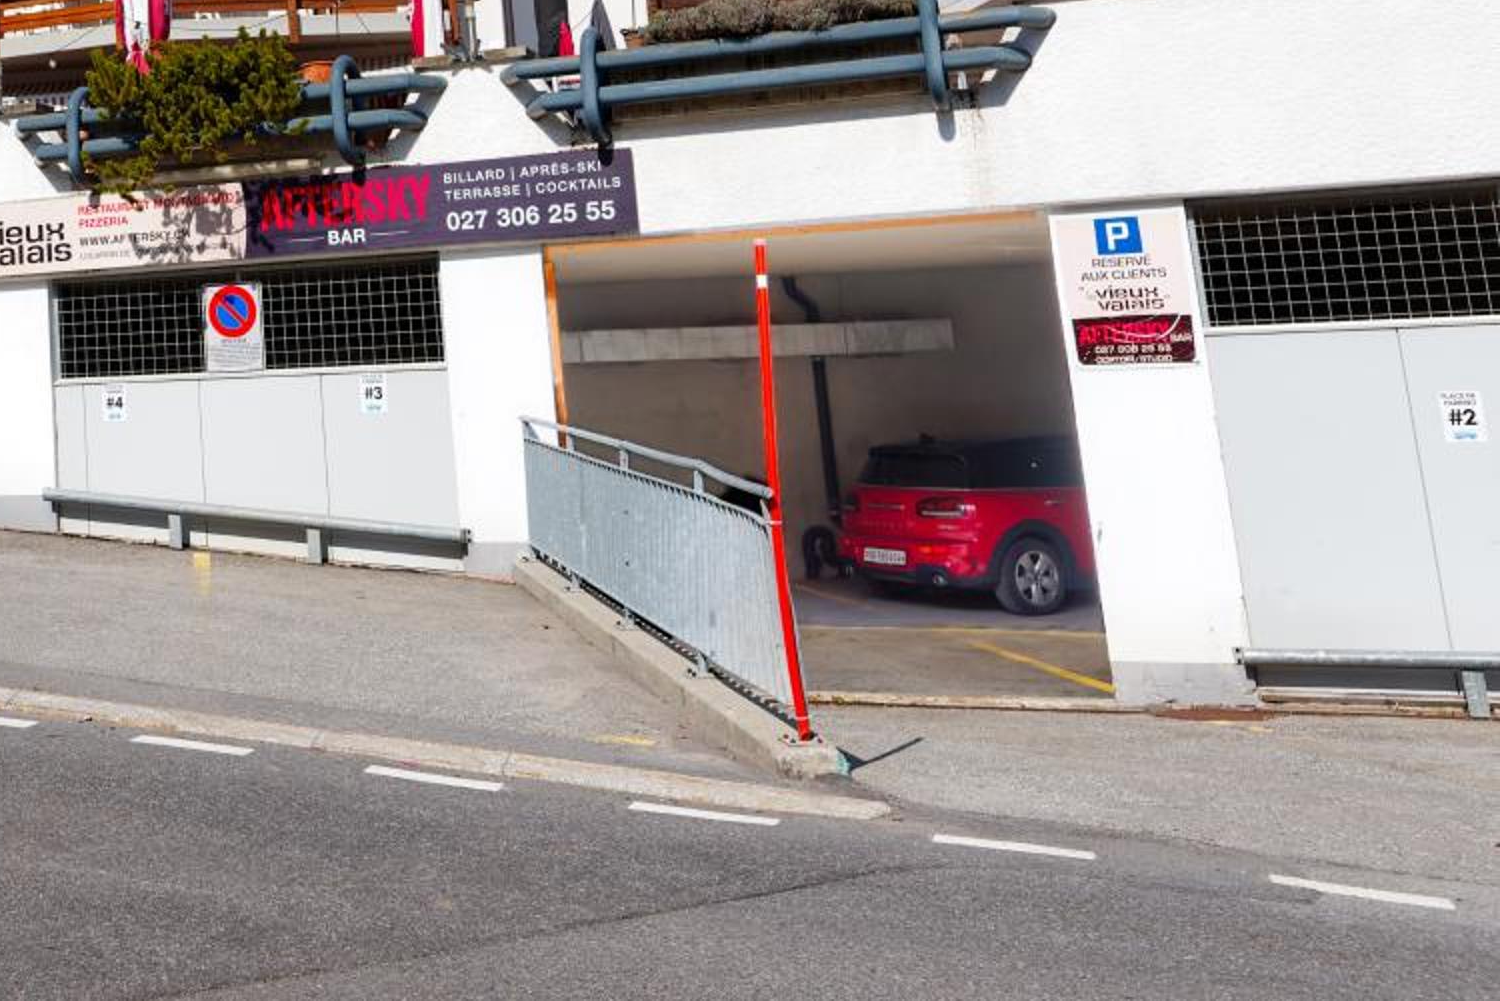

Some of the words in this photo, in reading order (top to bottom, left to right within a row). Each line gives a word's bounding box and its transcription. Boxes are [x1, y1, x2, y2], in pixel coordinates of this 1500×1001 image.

[443, 169, 505, 184] BILLARD
[444, 184, 521, 201] TERRASSE
[535, 176, 621, 194] COCKTAILS
[260, 172, 431, 232] AFTERSKY
[446, 209, 488, 231] 027
[497, 205, 541, 228] 306
[548, 202, 578, 224] 25
[586, 199, 617, 221] 55
[328, 228, 366, 246] BAR
[1105, 221, 1130, 251] P
[1081, 270, 1109, 282] AUX
[1111, 267, 1167, 280] CLIENTS
[1095, 285, 1158, 300] vieux
[1098, 298, 1165, 312] valais
[364, 386, 383, 400] #3
[106, 396, 123, 409] #4
[1448, 408, 1478, 426] #2
